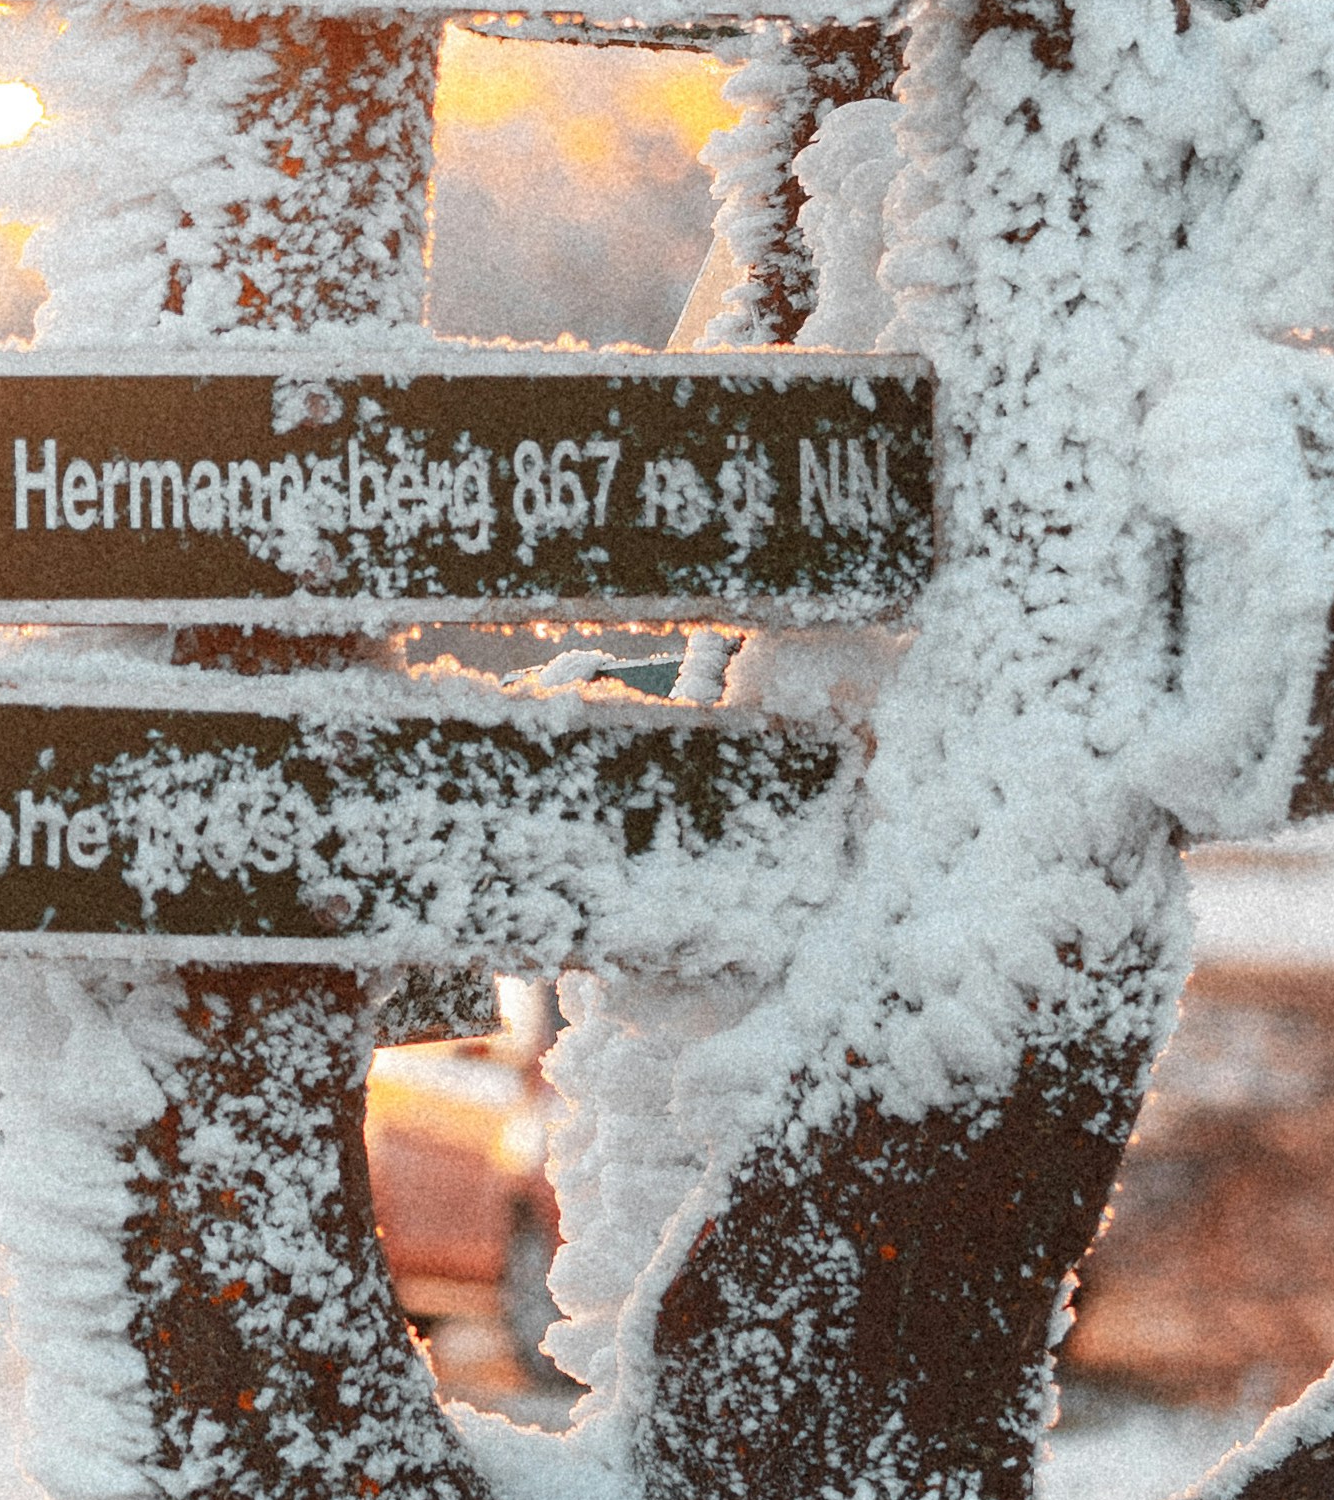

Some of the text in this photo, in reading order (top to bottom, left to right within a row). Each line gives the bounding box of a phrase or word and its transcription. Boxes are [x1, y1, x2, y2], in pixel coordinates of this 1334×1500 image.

[13, 437, 493, 555] Hermannsberg
[513, 439, 622, 530] 867
[799, 437, 893, 532] NN
